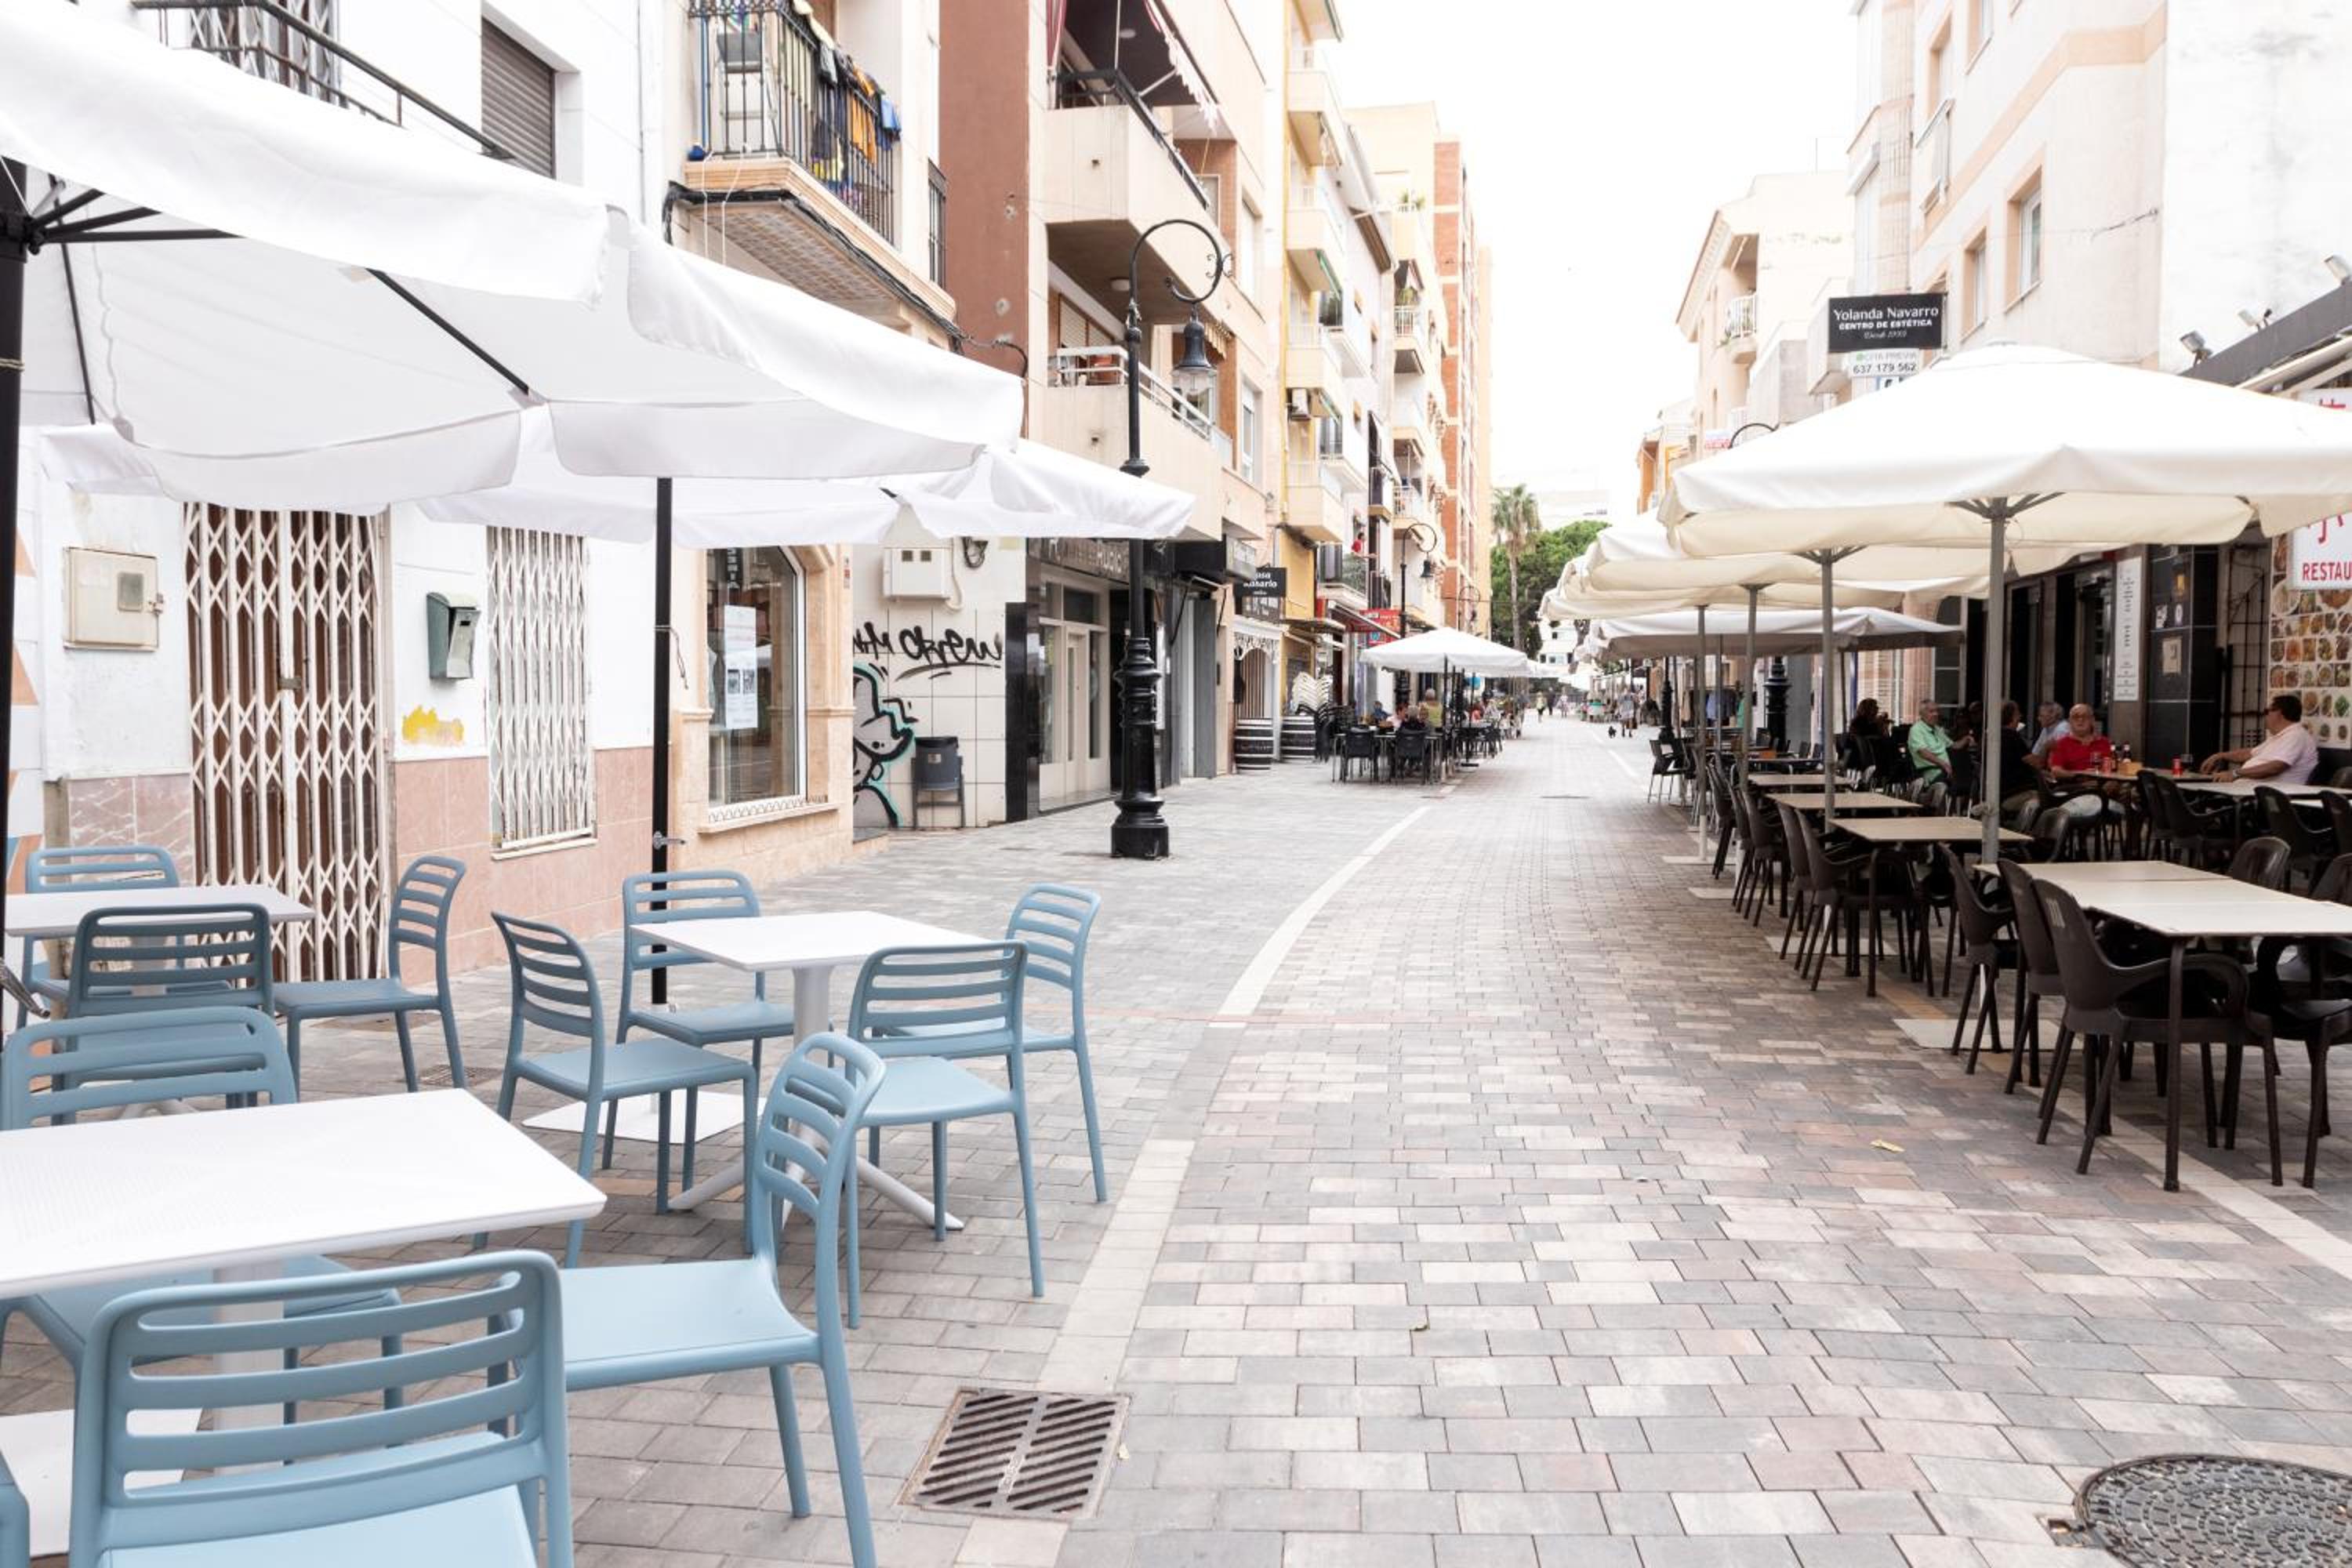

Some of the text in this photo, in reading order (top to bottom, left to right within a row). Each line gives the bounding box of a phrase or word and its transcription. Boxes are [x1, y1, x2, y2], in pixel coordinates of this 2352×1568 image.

[1834, 307, 1939, 321] Yolanda Navarro
[1853, 364, 1872, 374] 637
[2302, 561, 2352, 581] RESTAU
